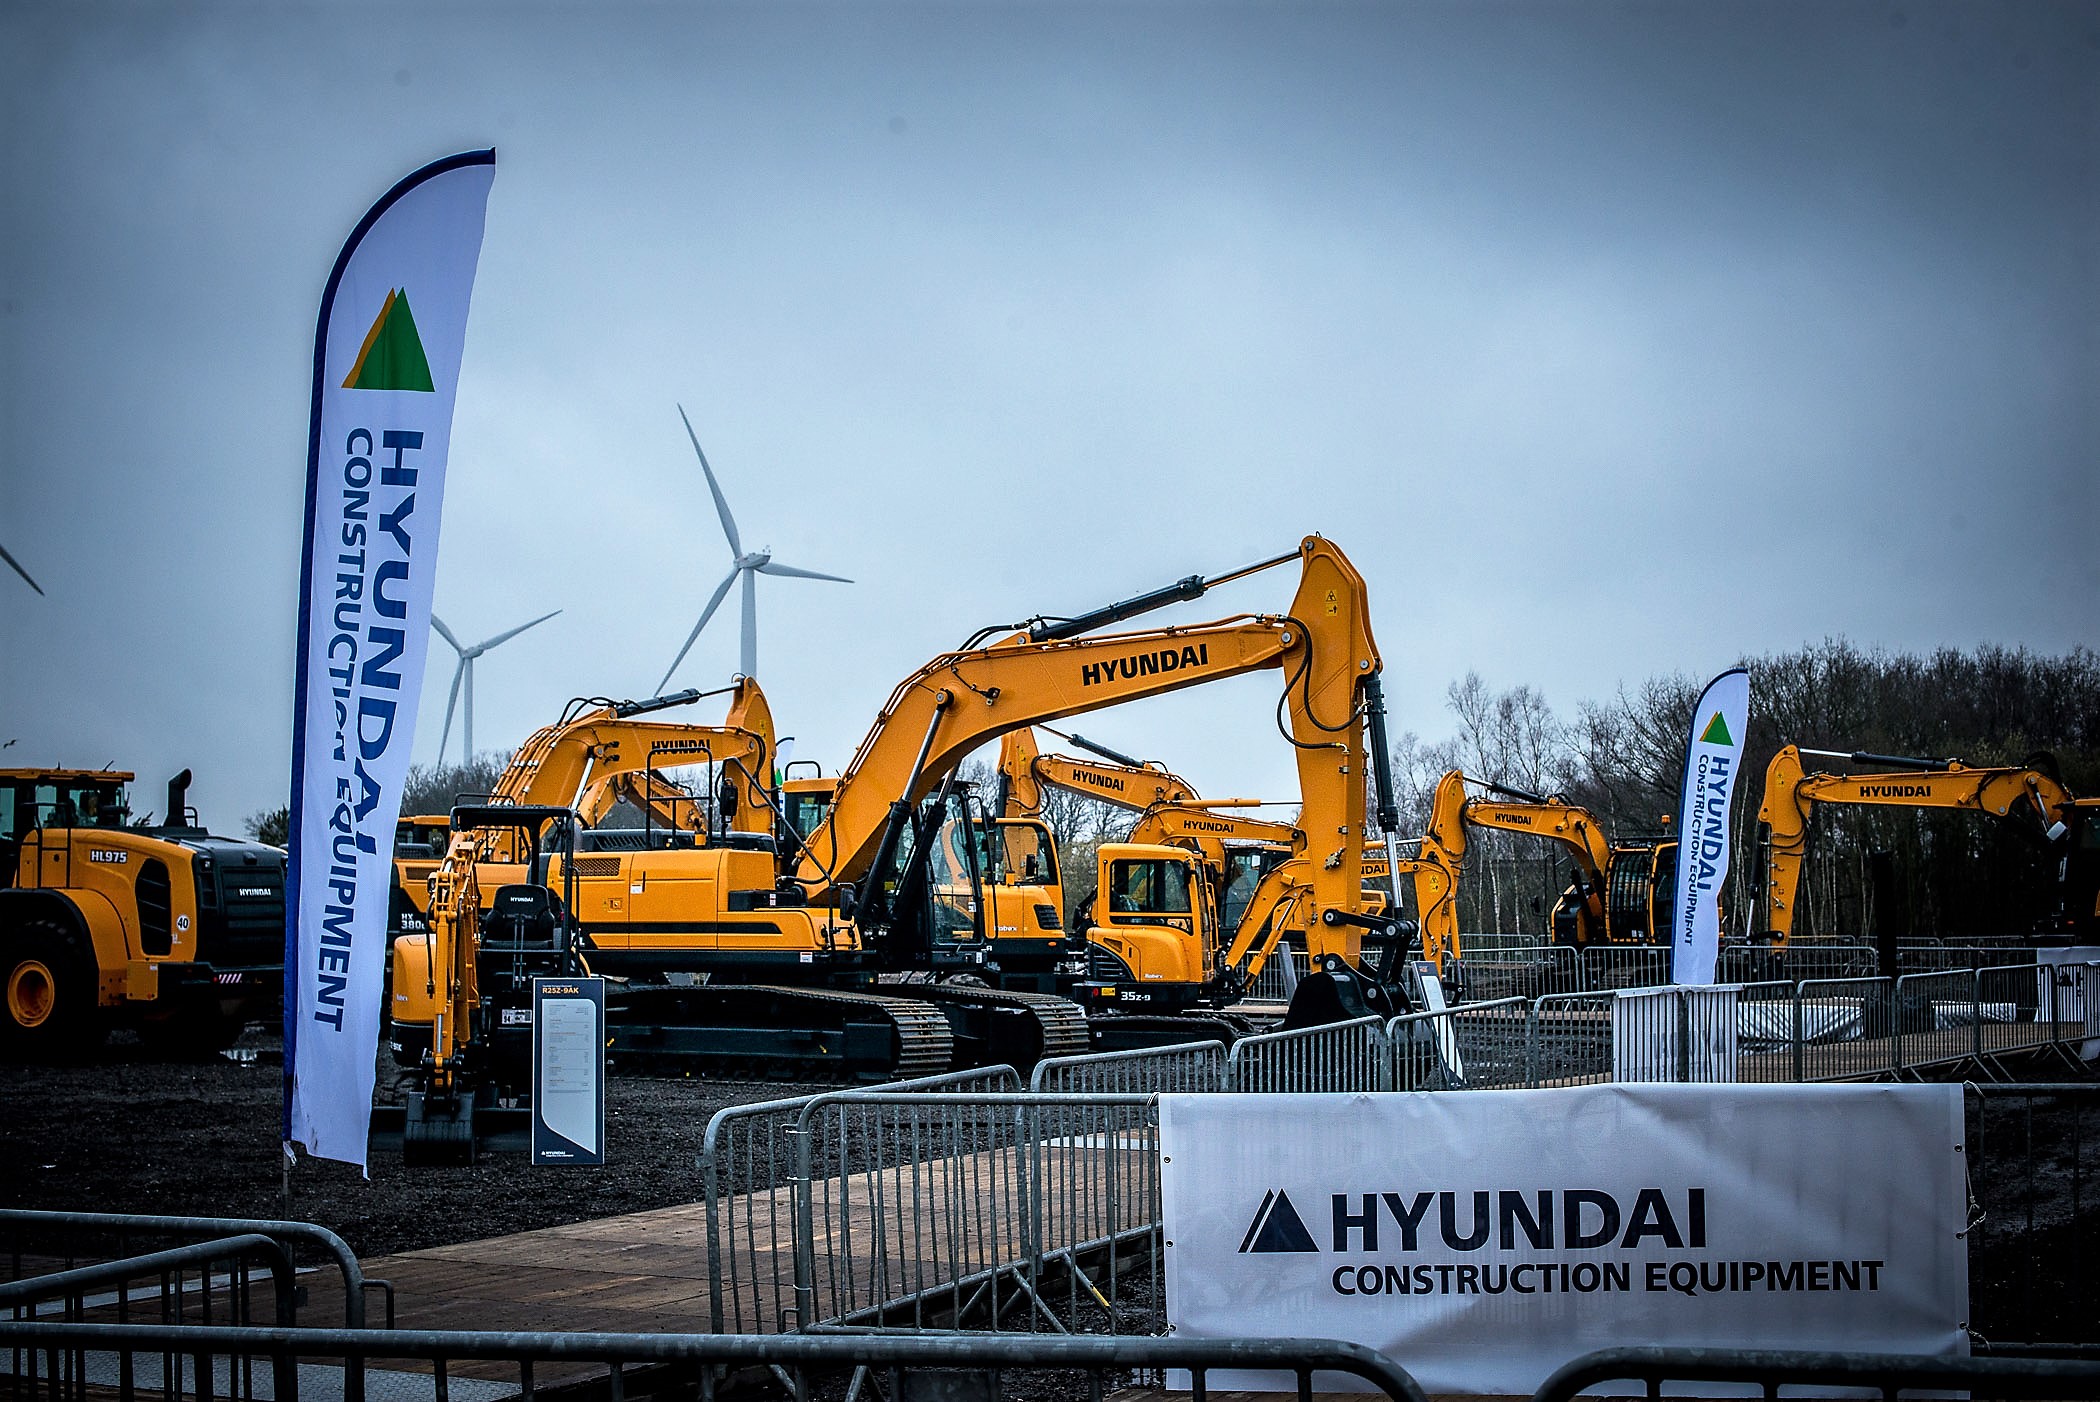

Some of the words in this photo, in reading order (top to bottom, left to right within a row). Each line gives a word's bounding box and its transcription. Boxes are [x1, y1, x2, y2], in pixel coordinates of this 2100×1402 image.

[353, 430, 424, 856] HYUNDAI
[1082, 643, 1208, 686] HYUNDAI
[651, 739, 711, 754] HYUNDAI
[1073, 769, 1124, 791] HYUNDAI
[1860, 785, 1931, 797] HYUNDAI
[1691, 754, 1709, 860] CONSTRUCTION
[1184, 820, 1234, 832] HYUNDAI
[1495, 813, 1532, 825] HYUNDAI
[1697, 756, 1730, 890] HYUNDAI
[91, 850, 127, 863] HL975
[239, 888, 271, 896] HYUNDAI
[314, 776, 357, 1033] EQUIPMENT
[177, 917, 189, 929] 40
[1331, 1188, 1706, 1253] HYUNDAI
[1331, 1262, 1630, 1296] CONSTRUCTION
[1645, 1260, 1884, 1298] EQUIPMENT
